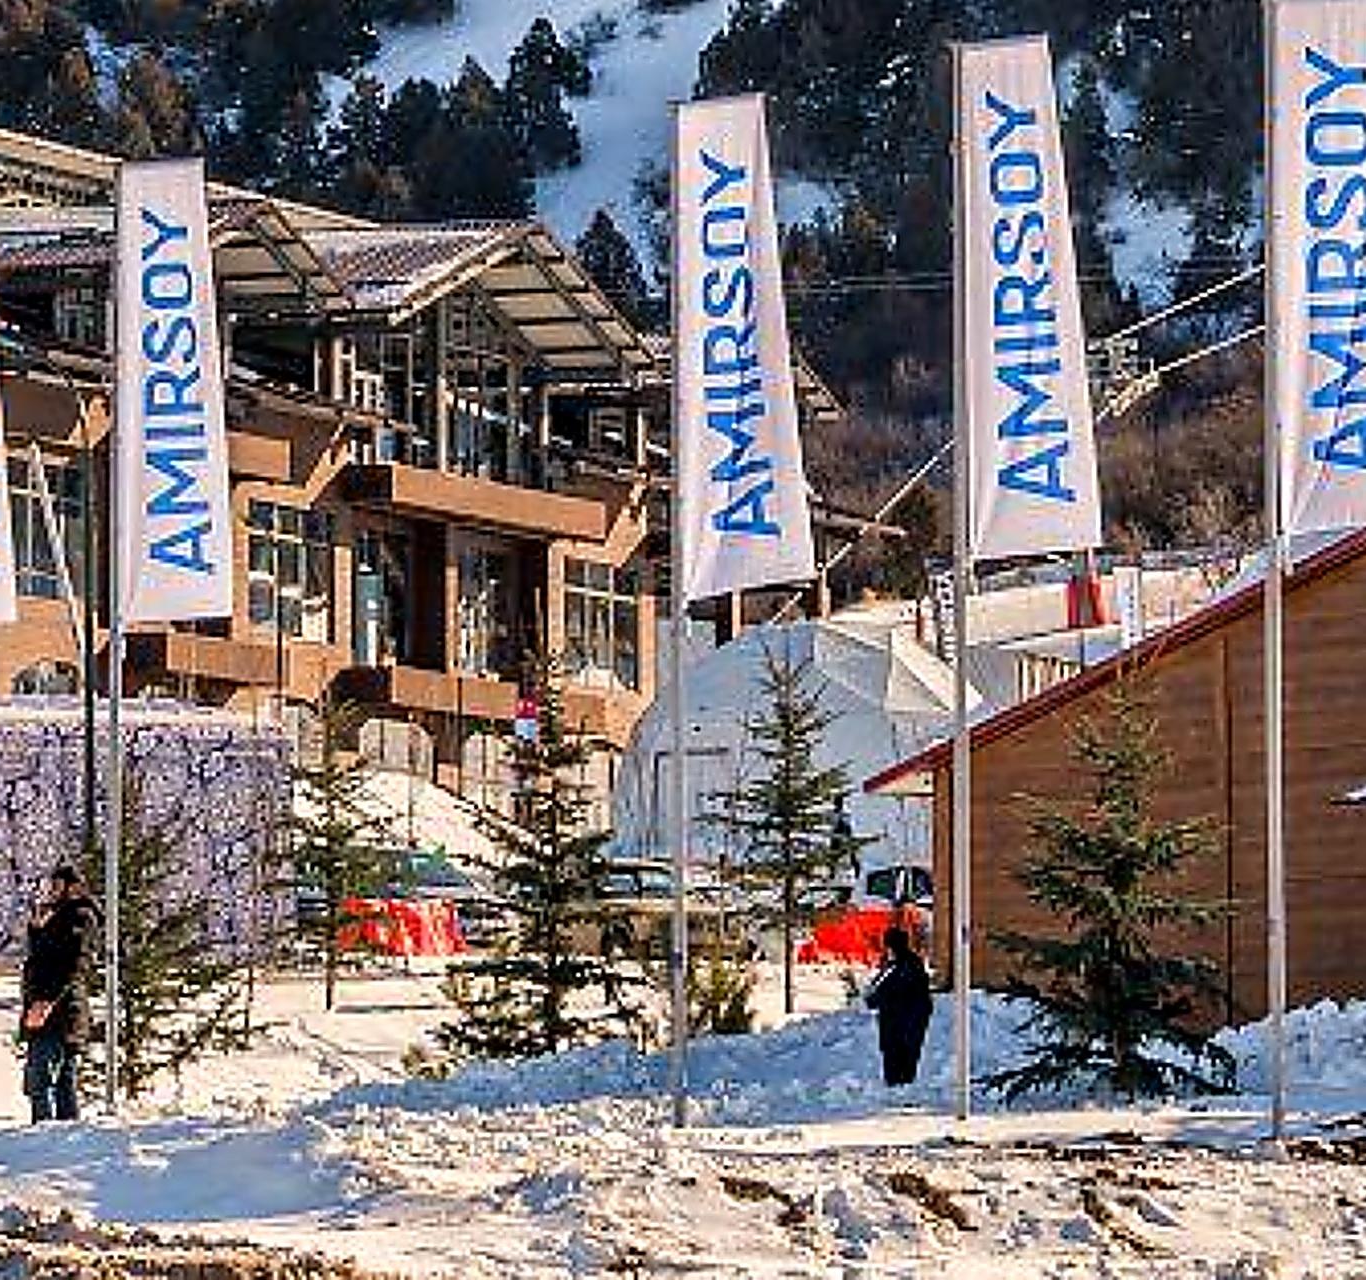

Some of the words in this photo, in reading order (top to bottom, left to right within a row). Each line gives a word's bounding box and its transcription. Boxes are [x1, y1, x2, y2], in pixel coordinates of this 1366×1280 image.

[141, 208, 214, 575] AMIRSOY
[700, 149, 782, 538] AMIRSOY
[984, 91, 1076, 504] AMIRSOY
